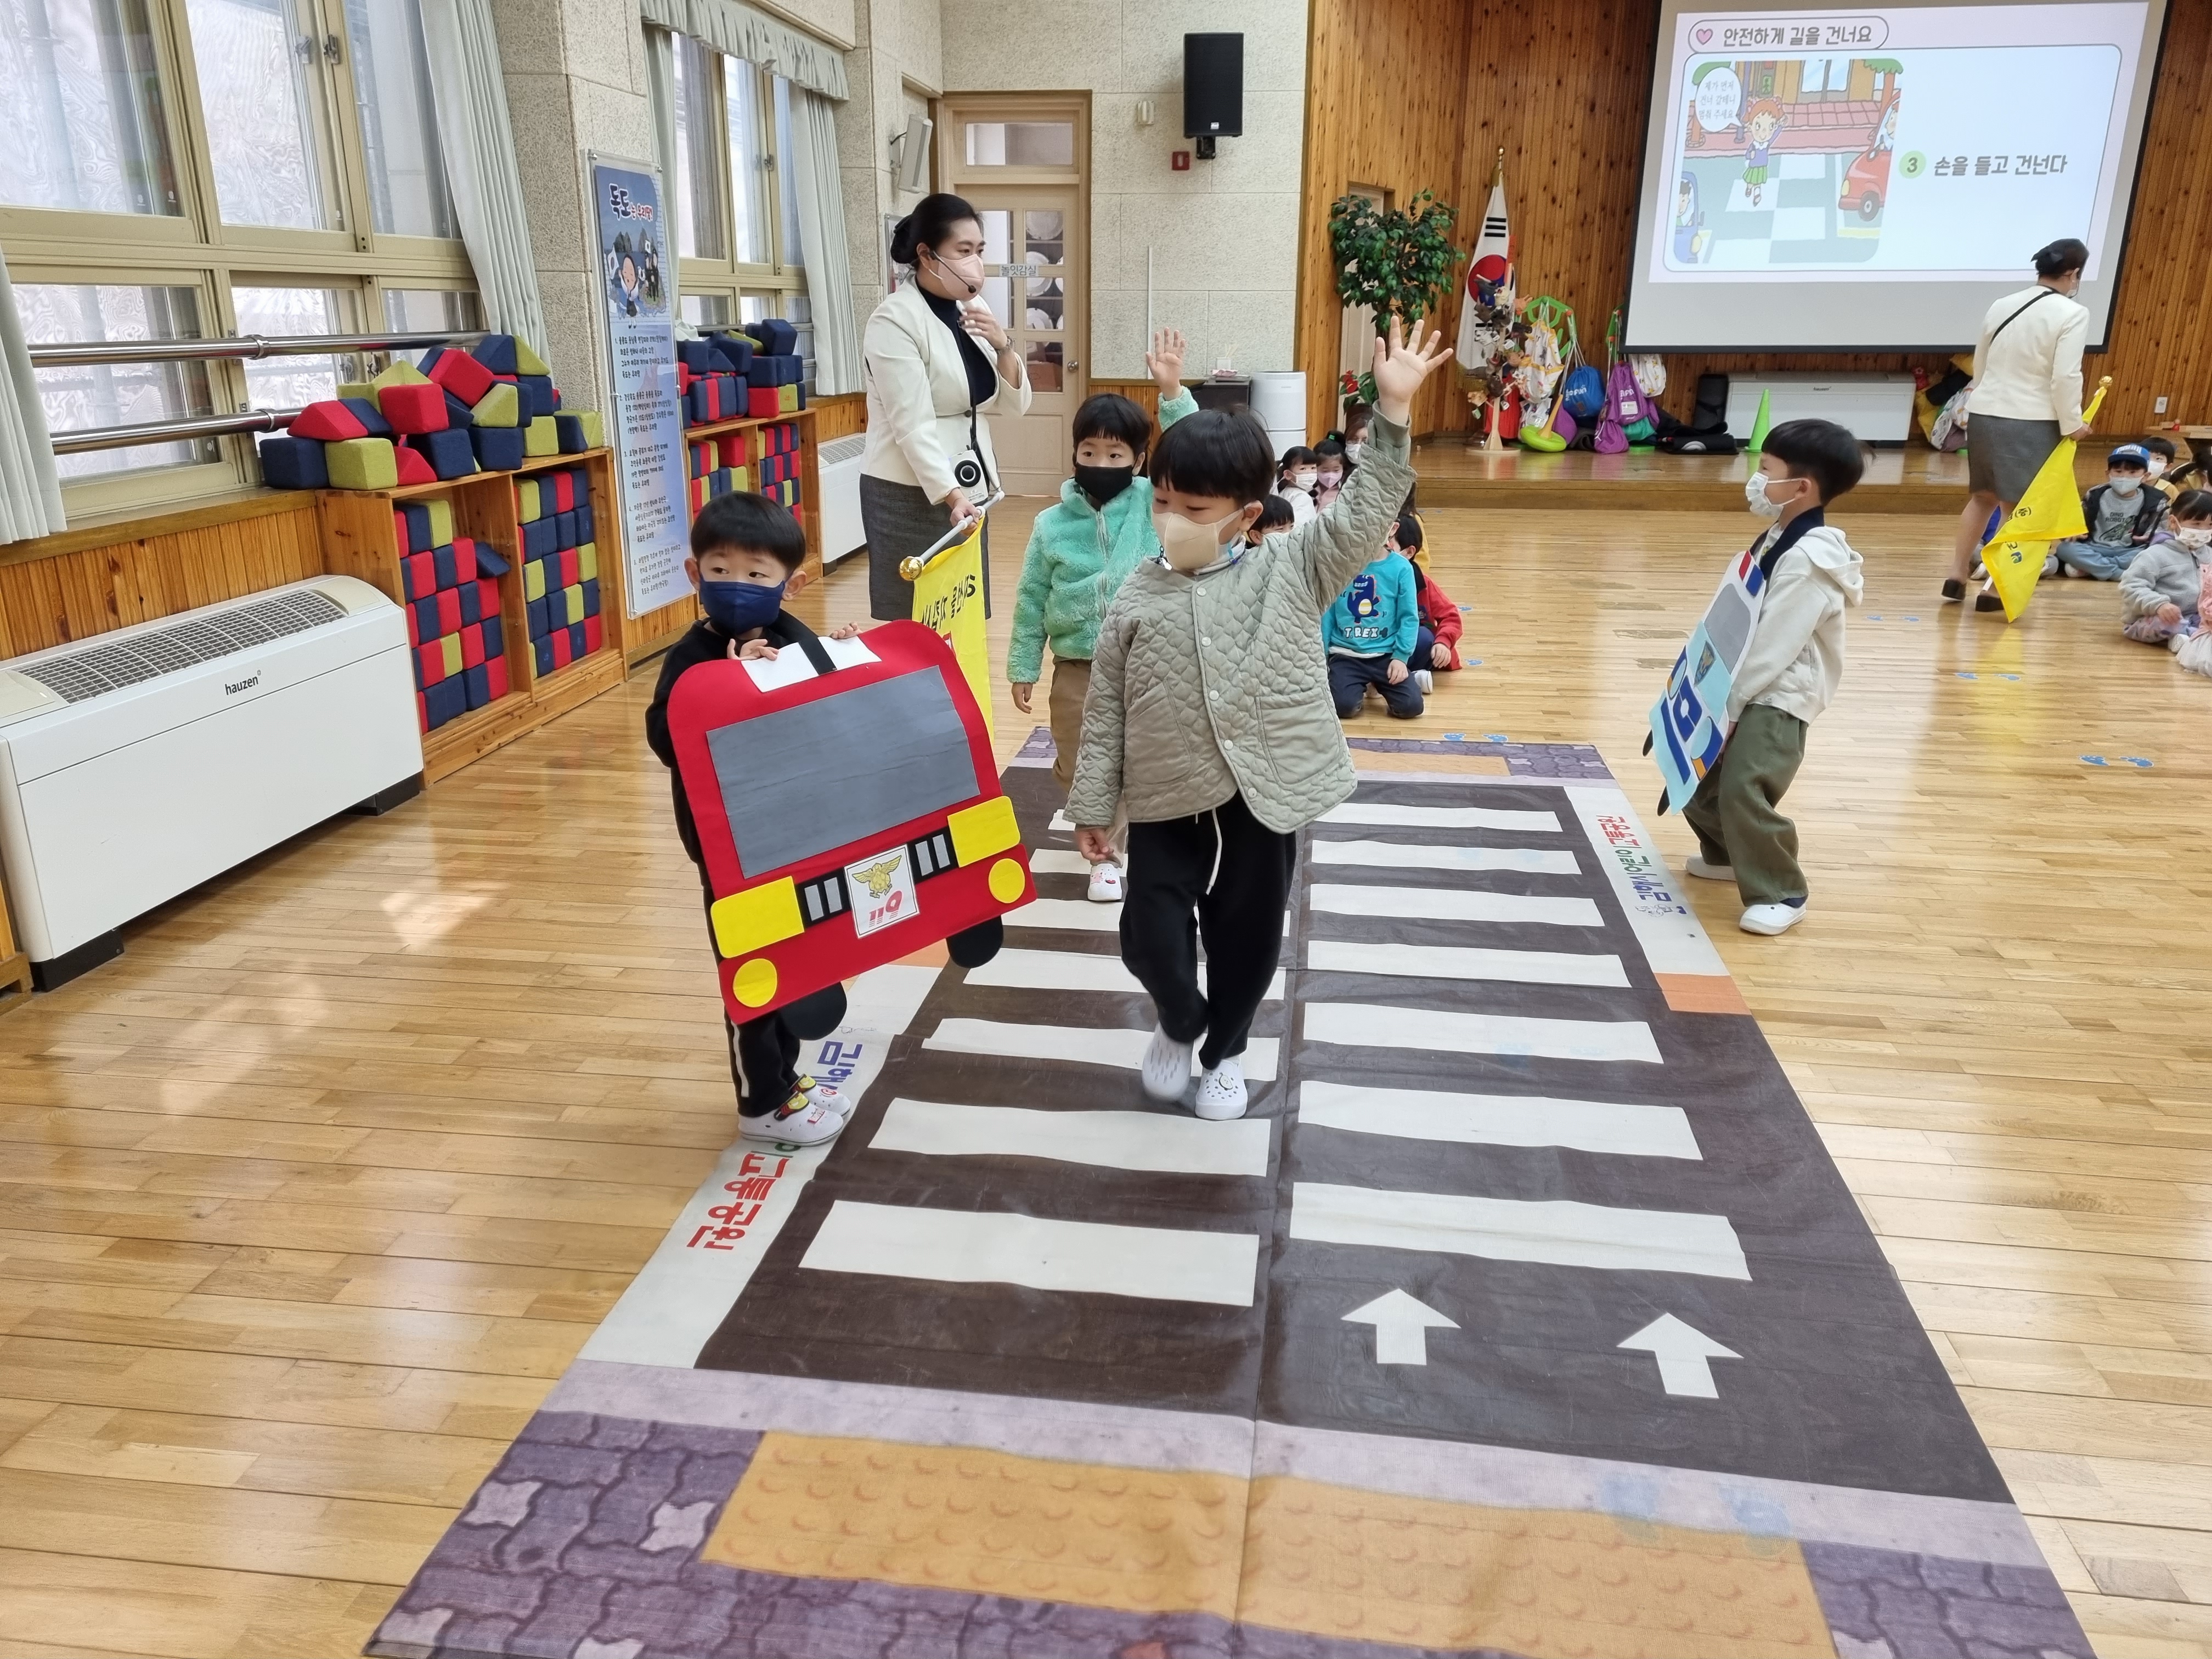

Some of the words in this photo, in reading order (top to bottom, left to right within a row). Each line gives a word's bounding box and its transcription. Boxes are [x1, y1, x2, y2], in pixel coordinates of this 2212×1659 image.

[1723, 27, 1784, 47] 안전하게
[1790, 27, 1820, 46] 길을
[1825, 25, 1872, 45] 건너요
[1907, 157, 1918, 173] 3
[1934, 156, 1968, 176] 손을
[1974, 156, 2008, 176] 들고
[2015, 155, 2068, 175] 건넌다
[610, 183, 636, 221] 독도는
[1001, 265, 1036, 276] 놀잇감실
[224, 675, 258, 695] hauzen
[868, 890, 904, 928] 119
